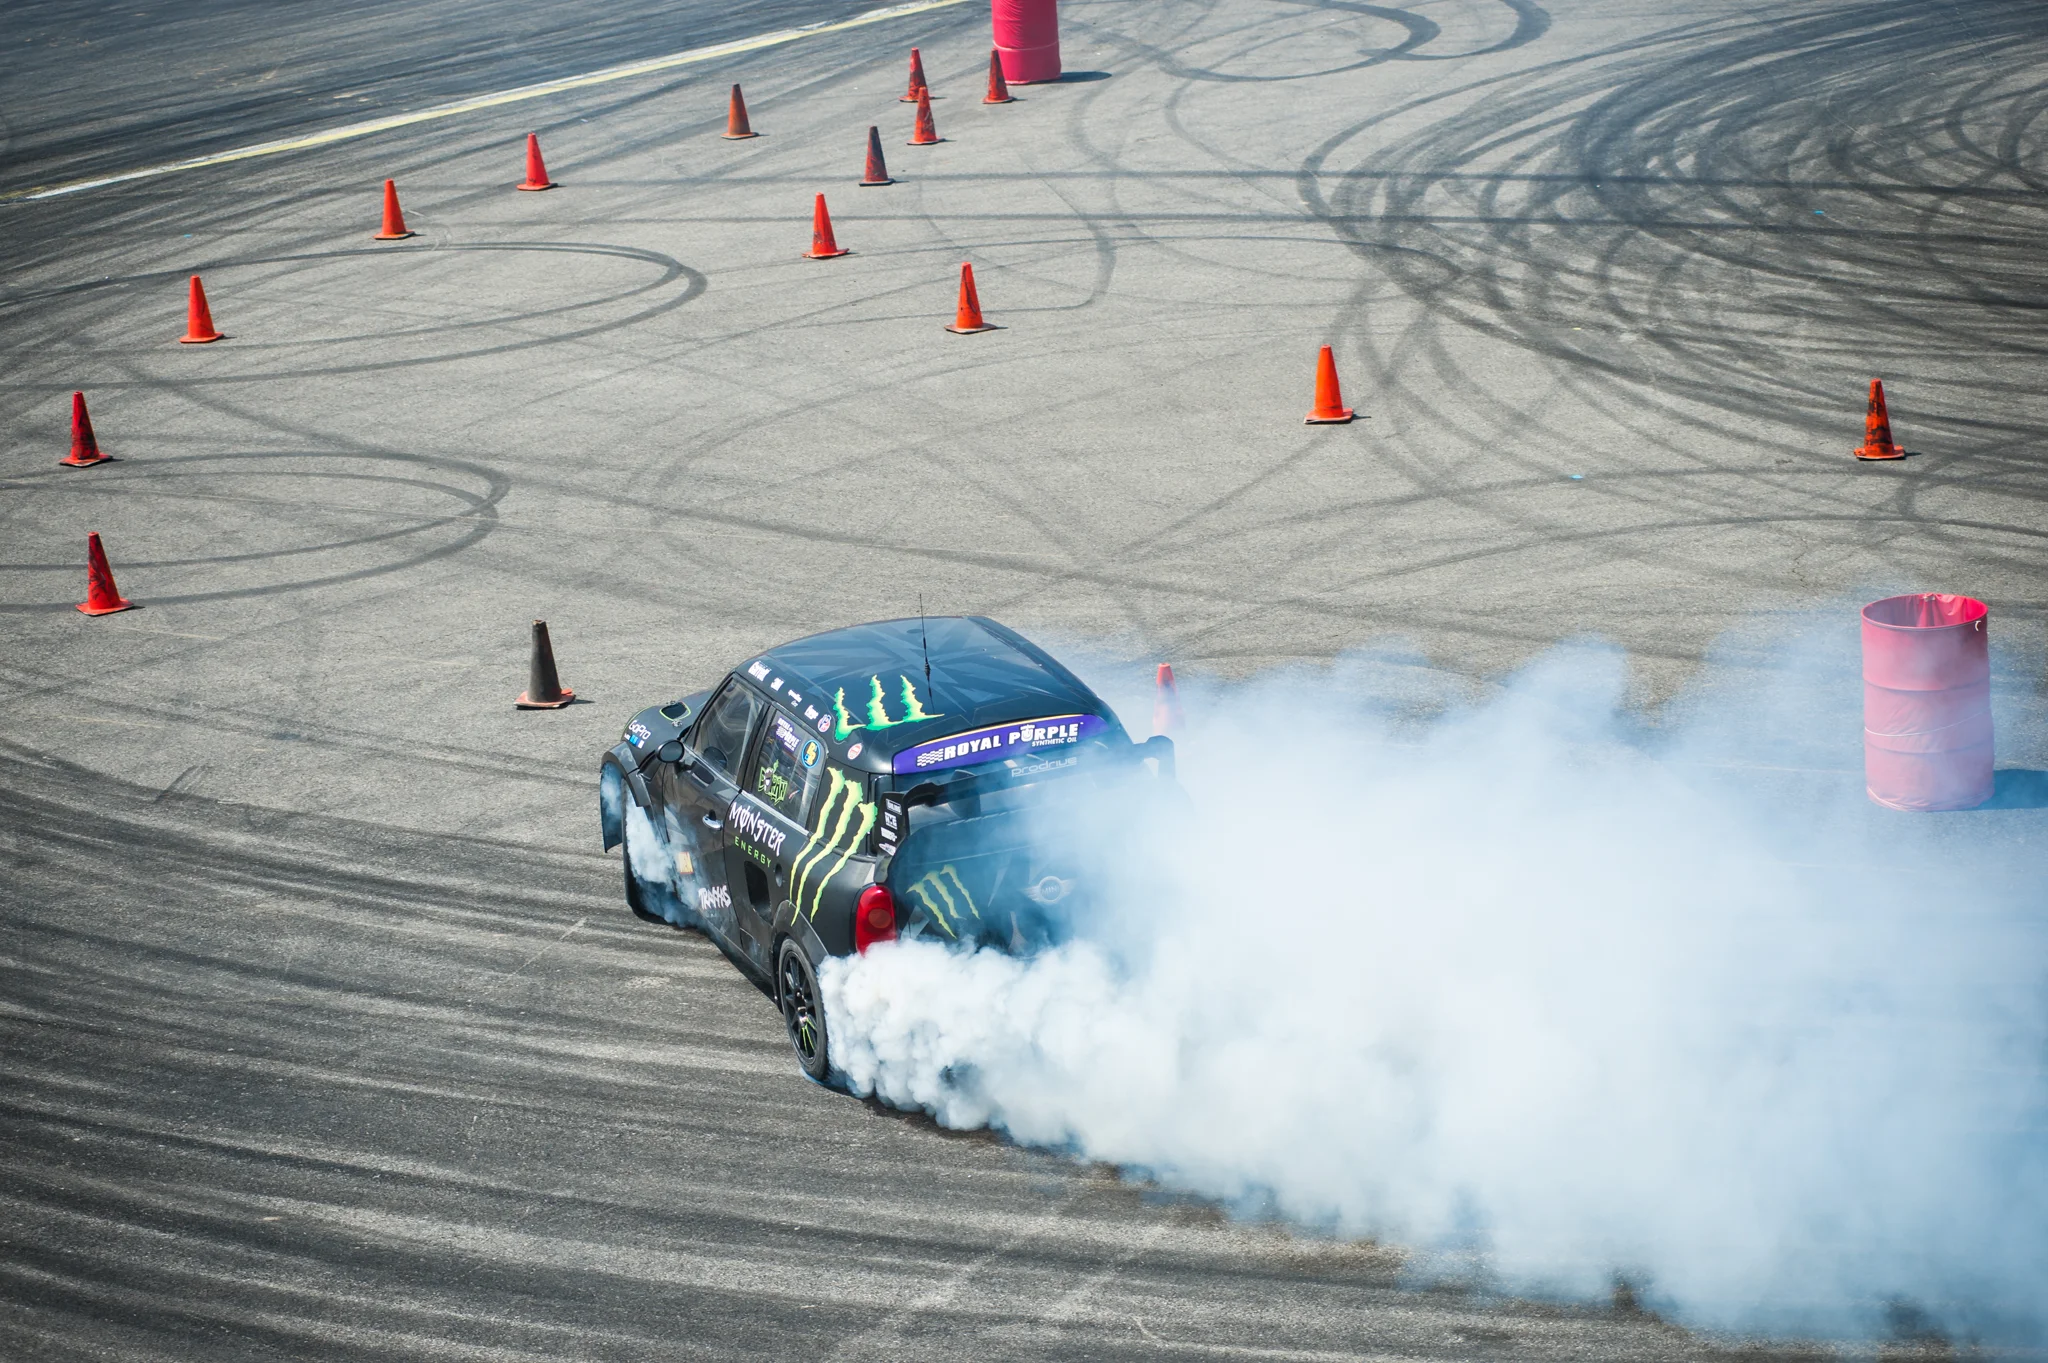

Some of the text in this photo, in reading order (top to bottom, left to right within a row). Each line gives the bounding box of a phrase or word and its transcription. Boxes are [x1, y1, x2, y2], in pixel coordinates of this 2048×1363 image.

[628, 719, 652, 740] GoPro
[943, 723, 1079, 761] ROYAL PURPLE
[1031, 736, 1078, 747] SYNTHETIC OIL
[1011, 756, 1078, 778] prodrive
[734, 835, 772, 868] ENERGY
